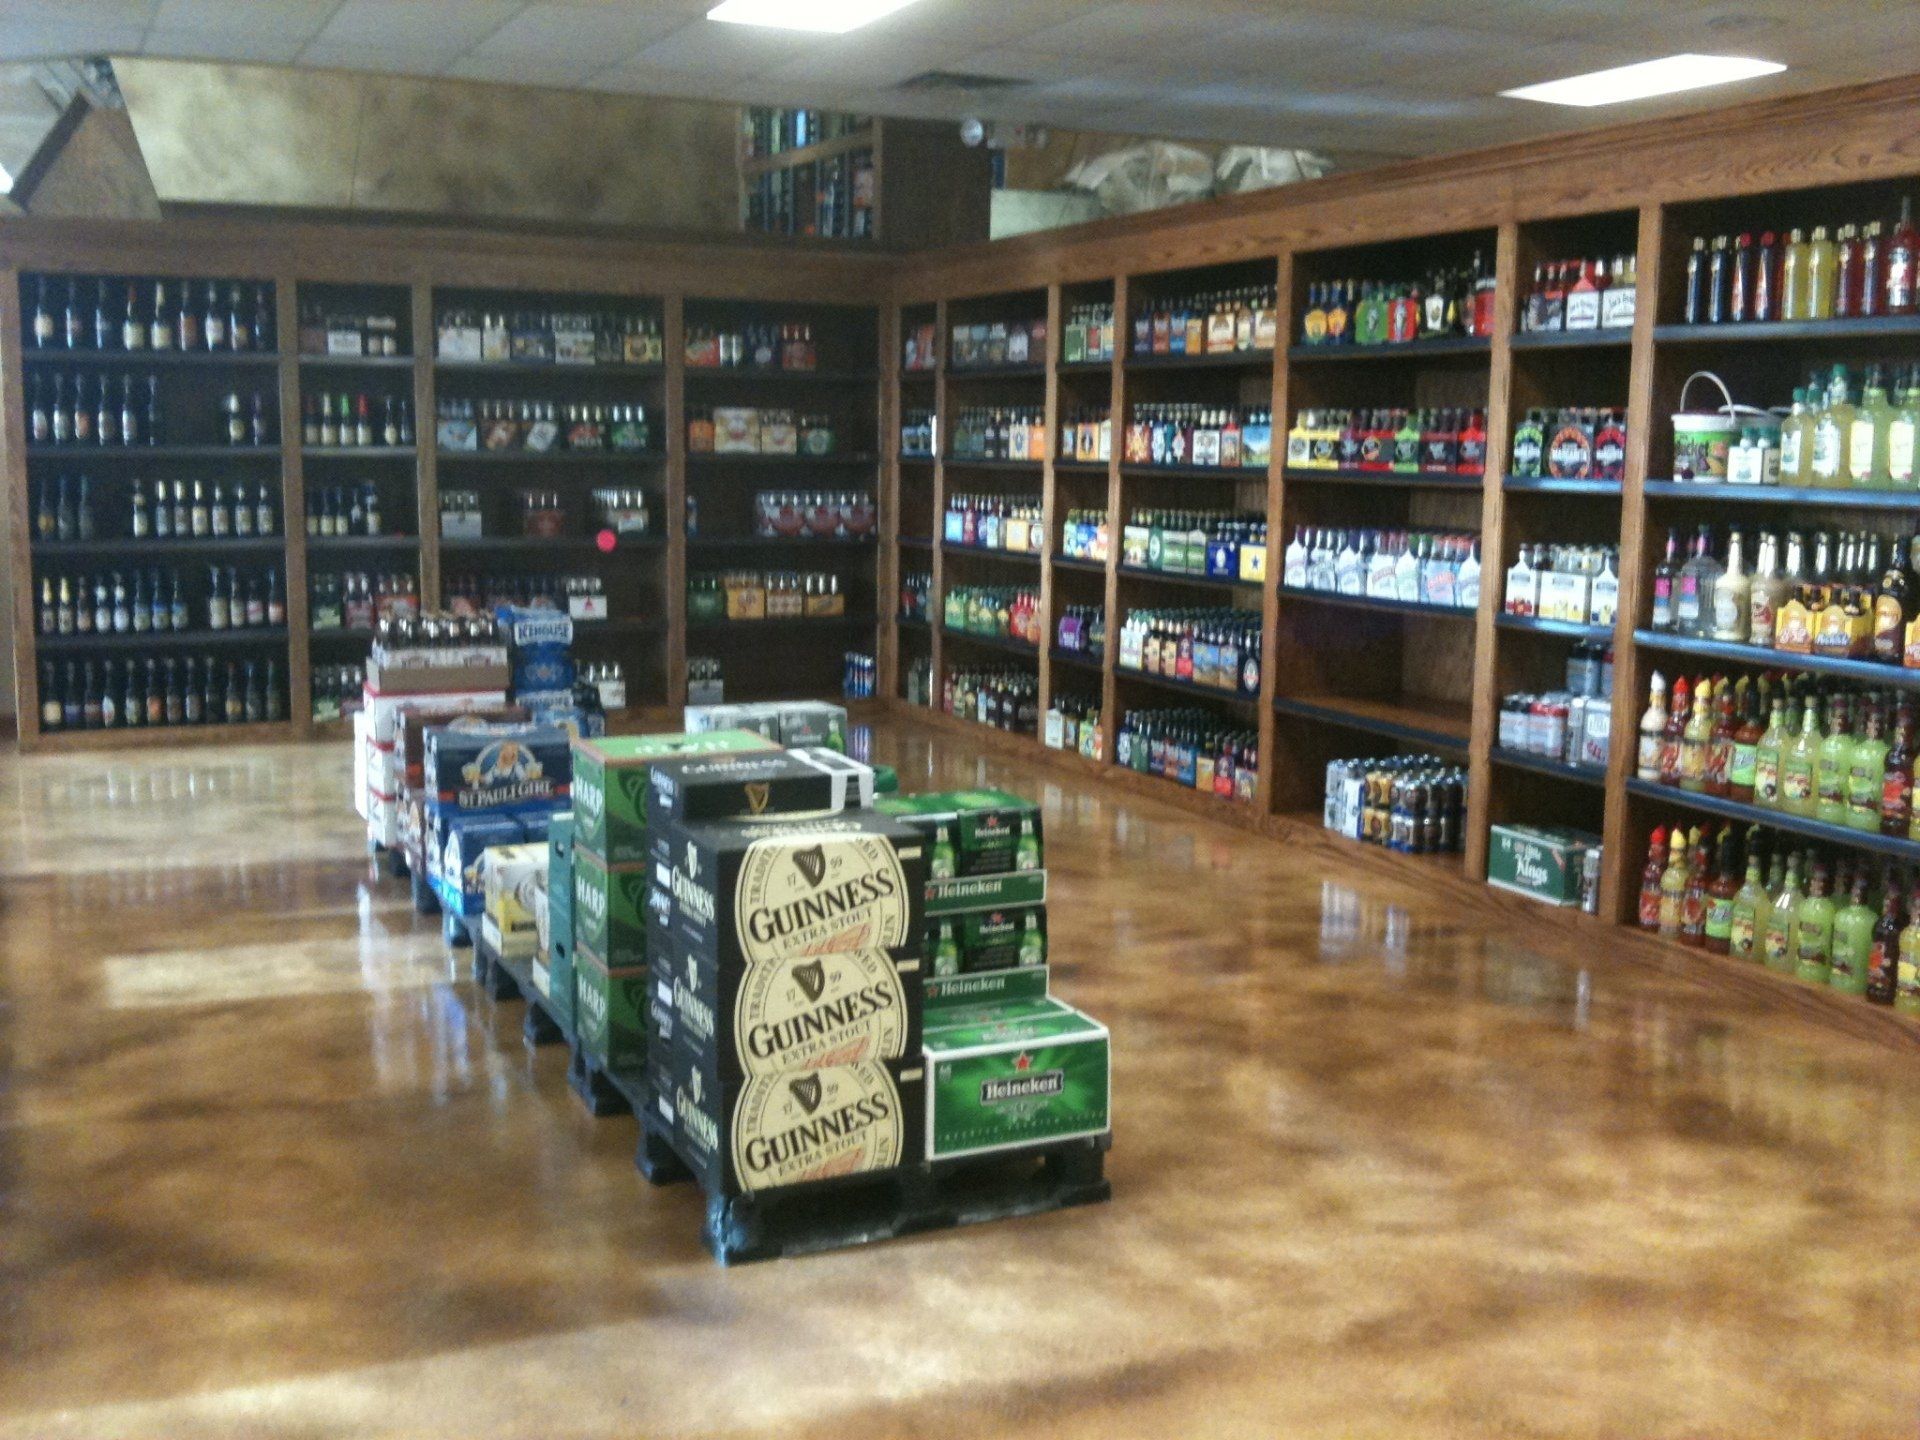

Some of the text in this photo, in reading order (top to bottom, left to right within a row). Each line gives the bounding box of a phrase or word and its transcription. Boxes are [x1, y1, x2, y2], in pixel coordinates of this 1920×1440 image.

[575, 774, 603, 817] HARP
[576, 874, 605, 919] HARP
[749, 867, 894, 944] GUINNESS
[938, 878, 1003, 898] Heineken
[782, 925, 828, 951] EXTRA
[831, 907, 871, 931] STOUT
[577, 973, 606, 1022] HARP
[940, 977, 1005, 997] Heineken
[748, 980, 893, 1059] GUINNESS
[782, 1037, 826, 1065] EXTRA
[829, 1019, 871, 1043] STOUT
[985, 1075, 1059, 1100] Heineken
[744, 1091, 889, 1173] GUINNESS
[777, 1149, 822, 1177] EXTRA
[825, 1131, 867, 1153] STOUT
